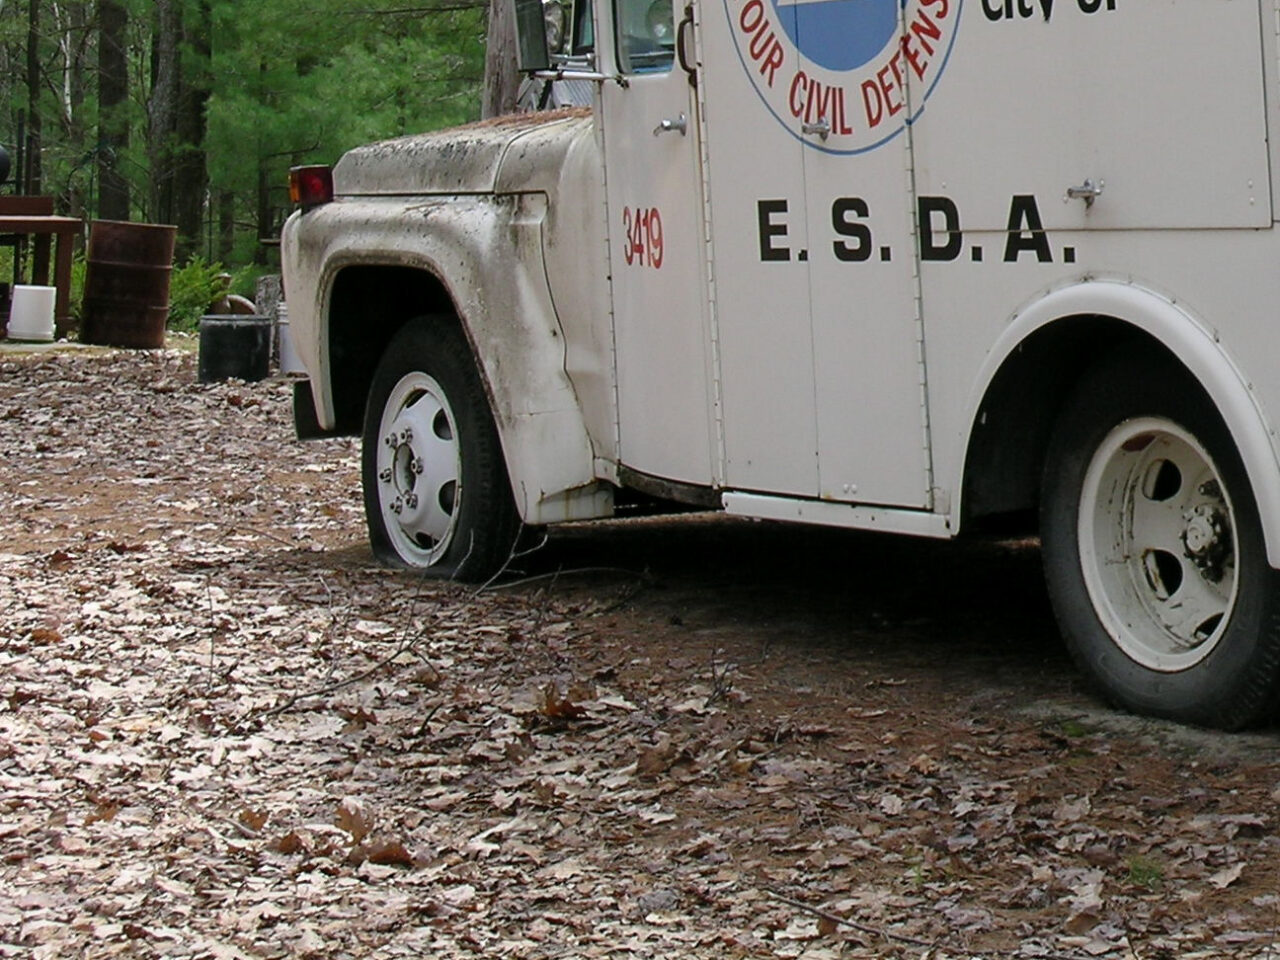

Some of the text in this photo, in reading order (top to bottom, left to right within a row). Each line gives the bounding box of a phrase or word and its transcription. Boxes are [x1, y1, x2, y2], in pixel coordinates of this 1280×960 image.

[789, 71, 853, 135] CIVIL
[623, 205, 664, 270] 3419
[757, 194, 1076, 263] E.S.D.A.
